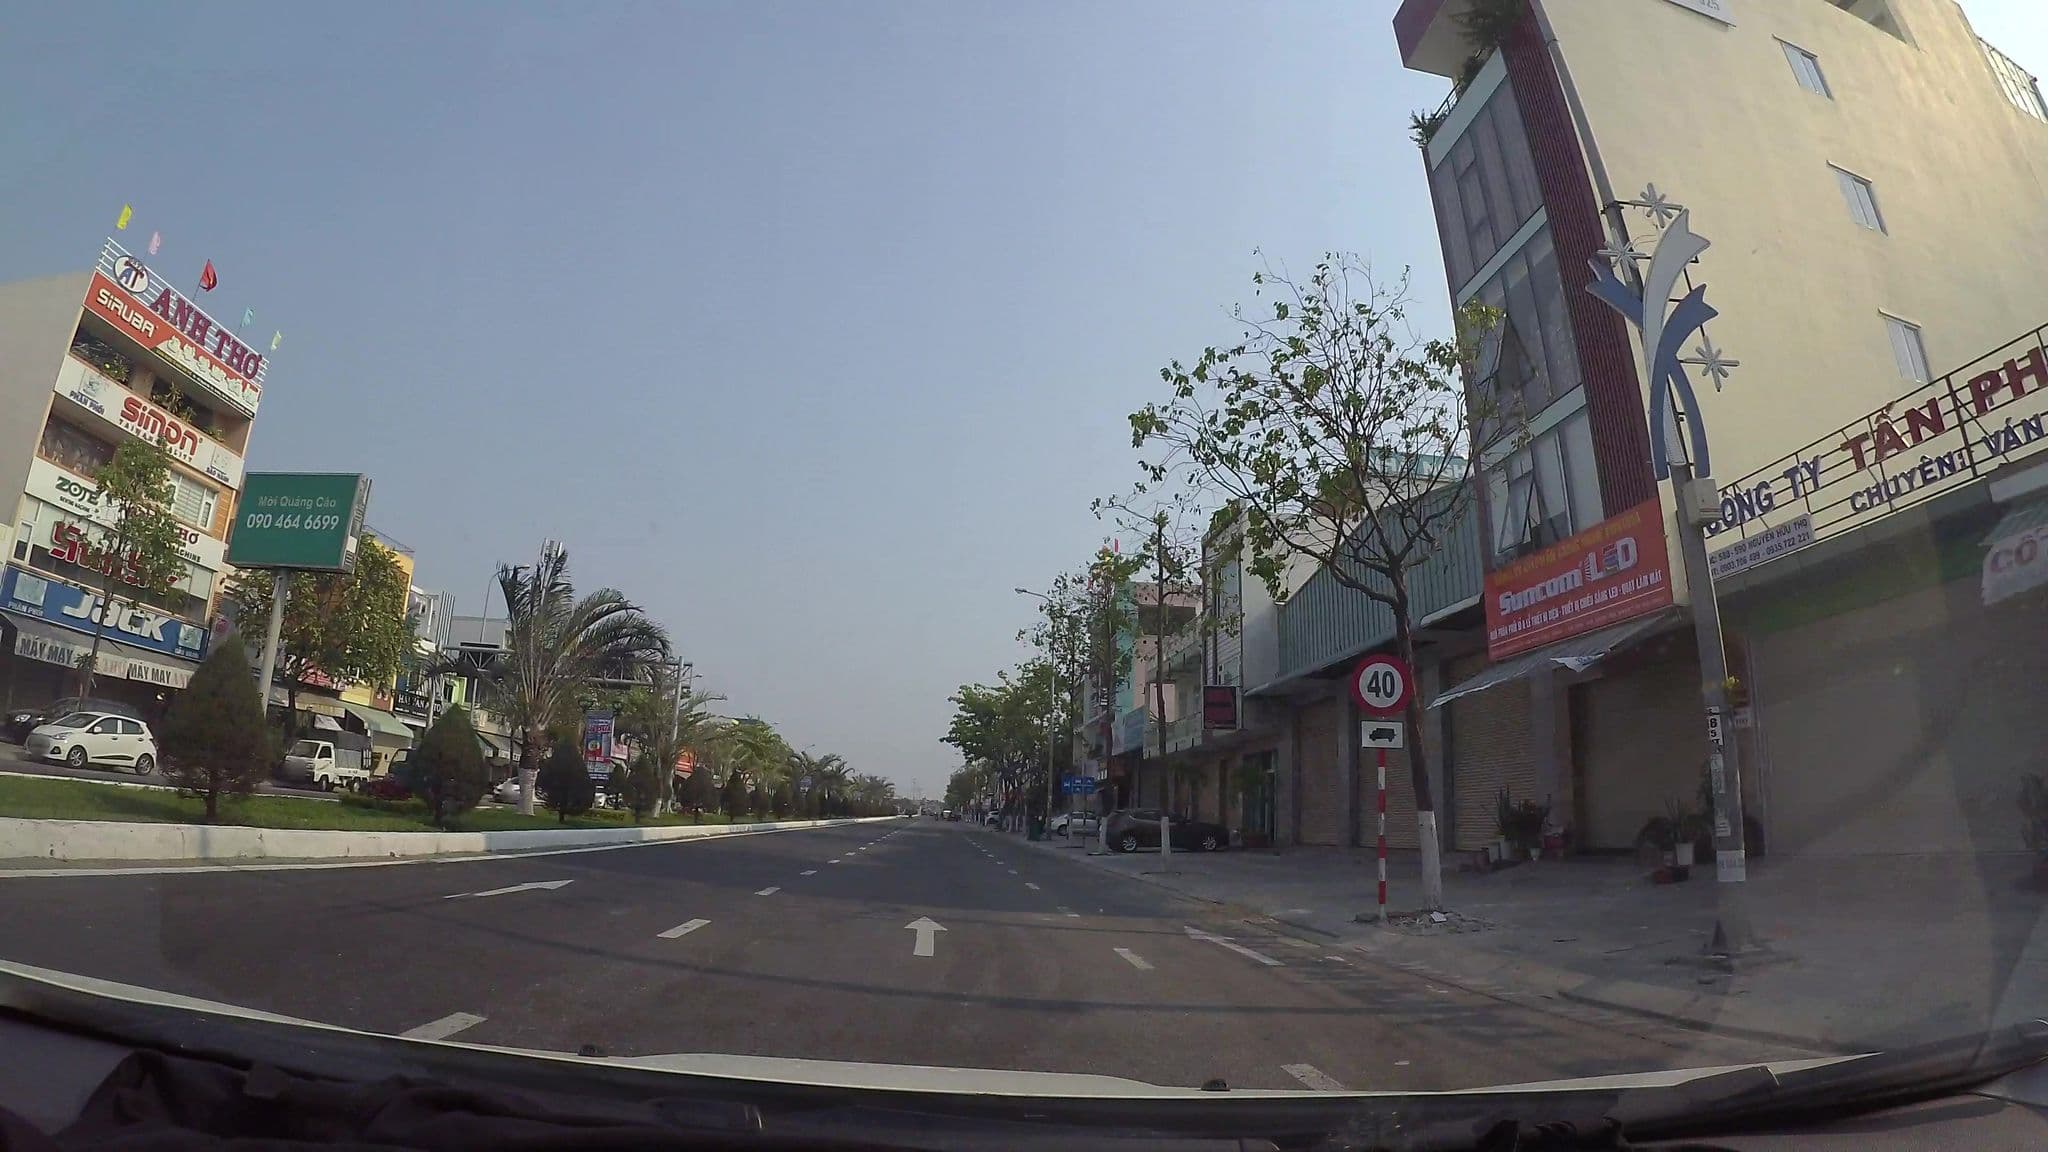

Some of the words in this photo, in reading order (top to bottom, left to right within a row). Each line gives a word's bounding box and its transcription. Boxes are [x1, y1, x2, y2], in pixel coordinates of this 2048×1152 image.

[151, 288, 211, 346] ANH
[214, 329, 262, 379] THƠ
[1783, 455, 1822, 500] TY
[246, 514, 273, 529] 090
[274, 514, 300, 529] 464
[304, 514, 340, 530] 6699
[20, 635, 46, 656] MÁY
[48, 645, 74, 665] MAY
[128, 662, 149, 680] MÁY
[151, 668, 171, 684] MAY
[1367, 670, 1395, 699] 40
